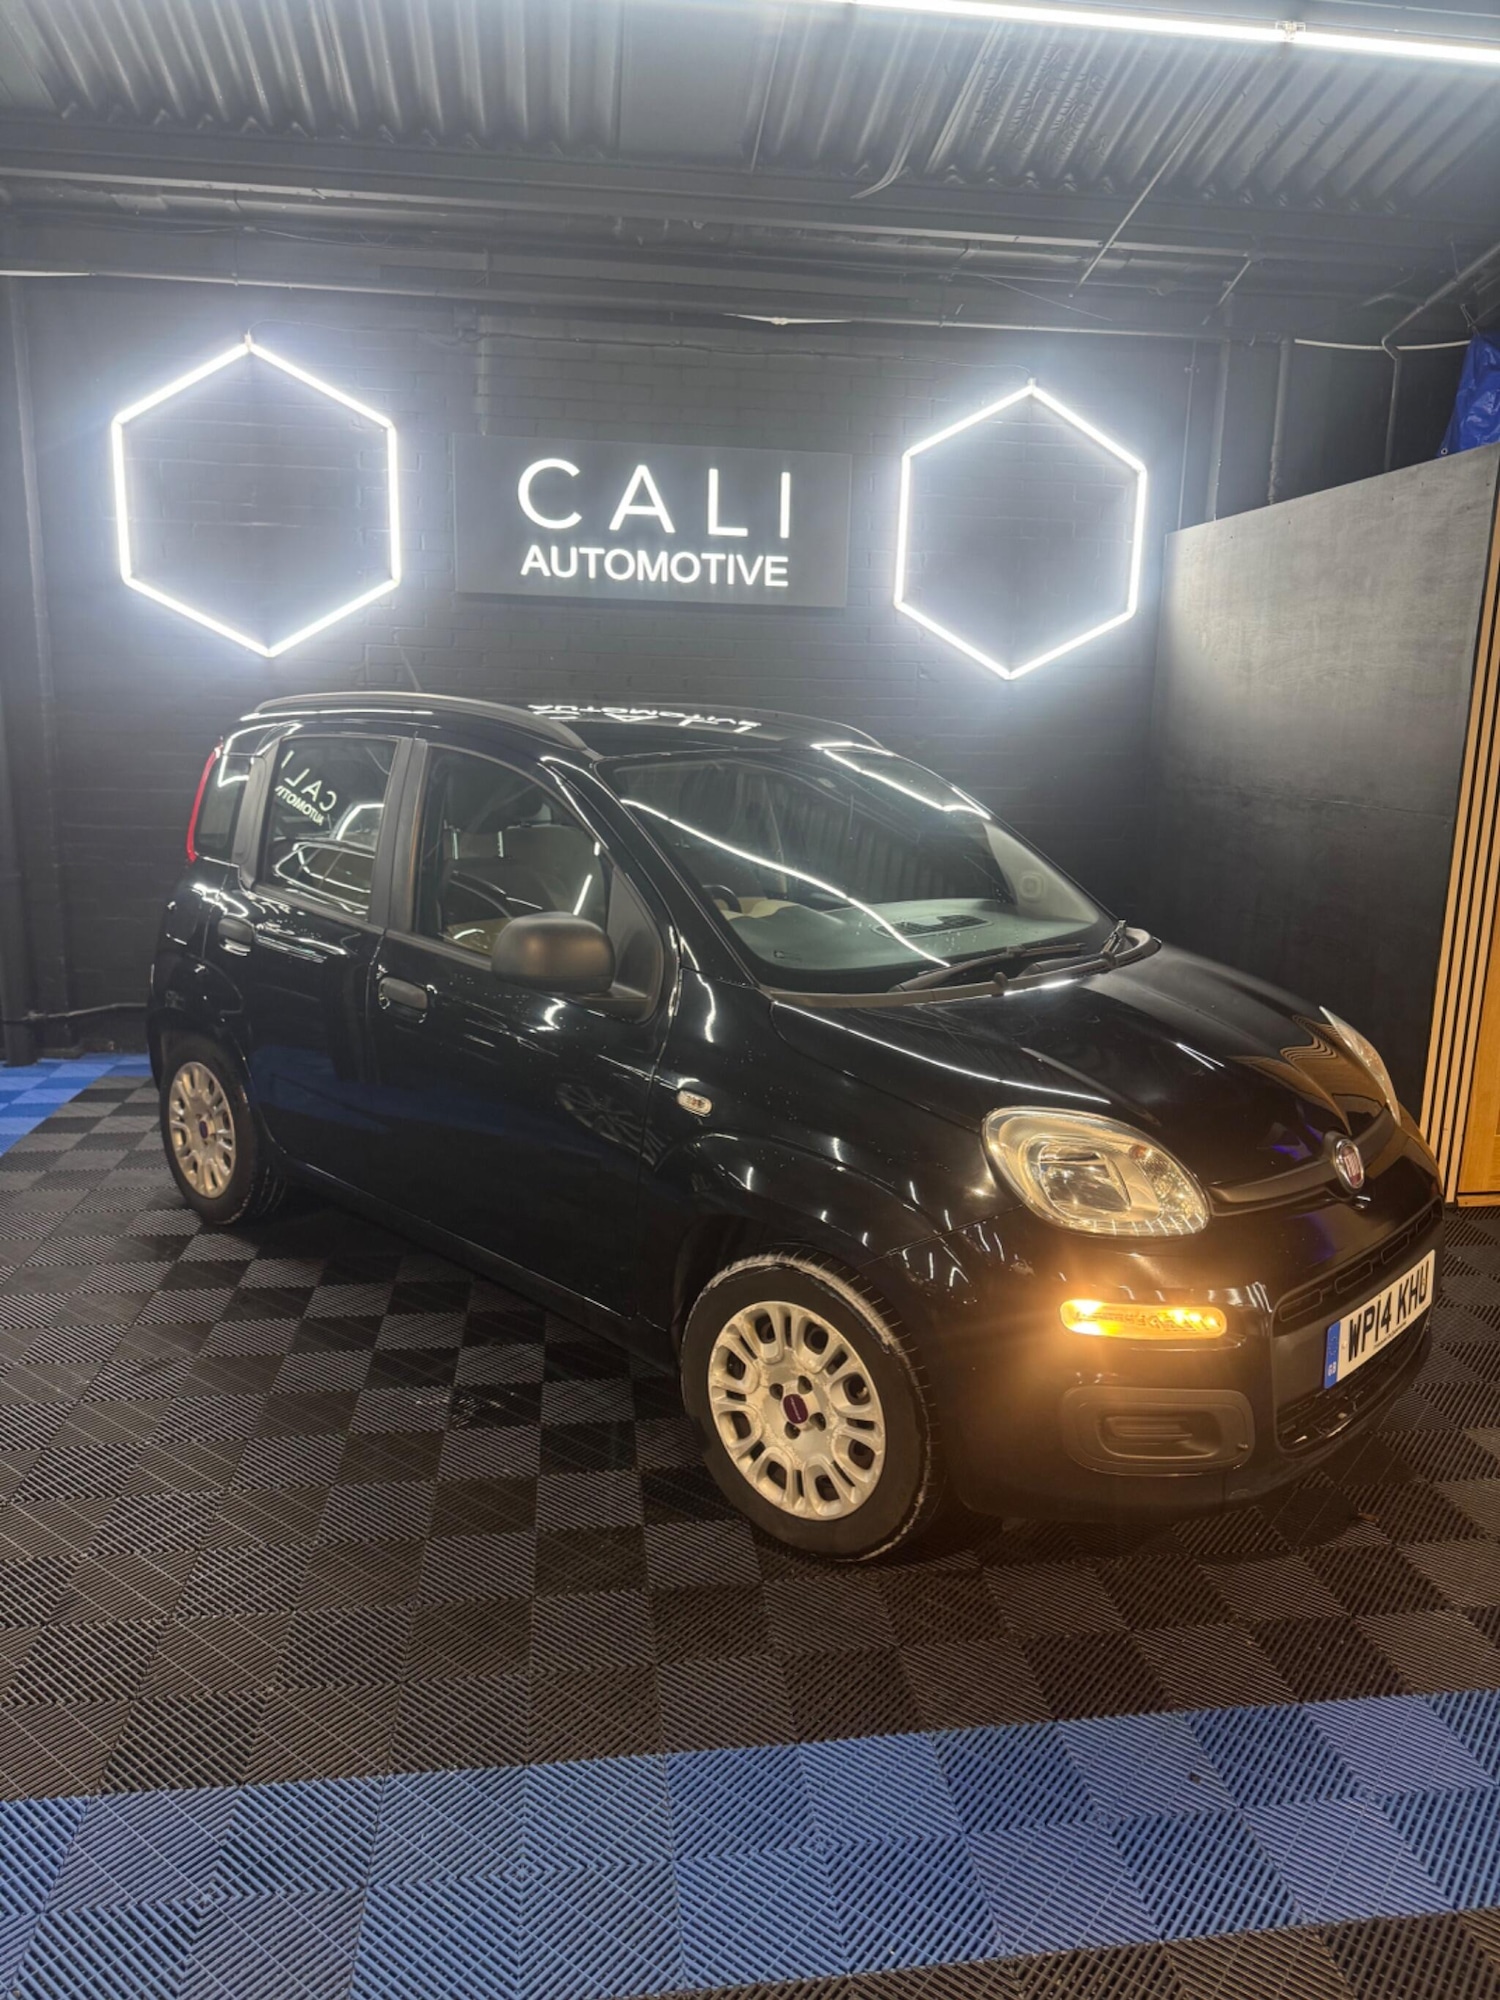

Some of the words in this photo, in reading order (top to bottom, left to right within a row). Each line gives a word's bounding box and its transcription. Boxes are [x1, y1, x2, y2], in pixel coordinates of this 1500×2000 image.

[518, 458, 791, 539] CALI
[520, 544, 789, 587] AUTOMOTIVE
[1347, 1290, 1393, 1363] WP14
[1396, 1260, 1430, 1325] KHU
